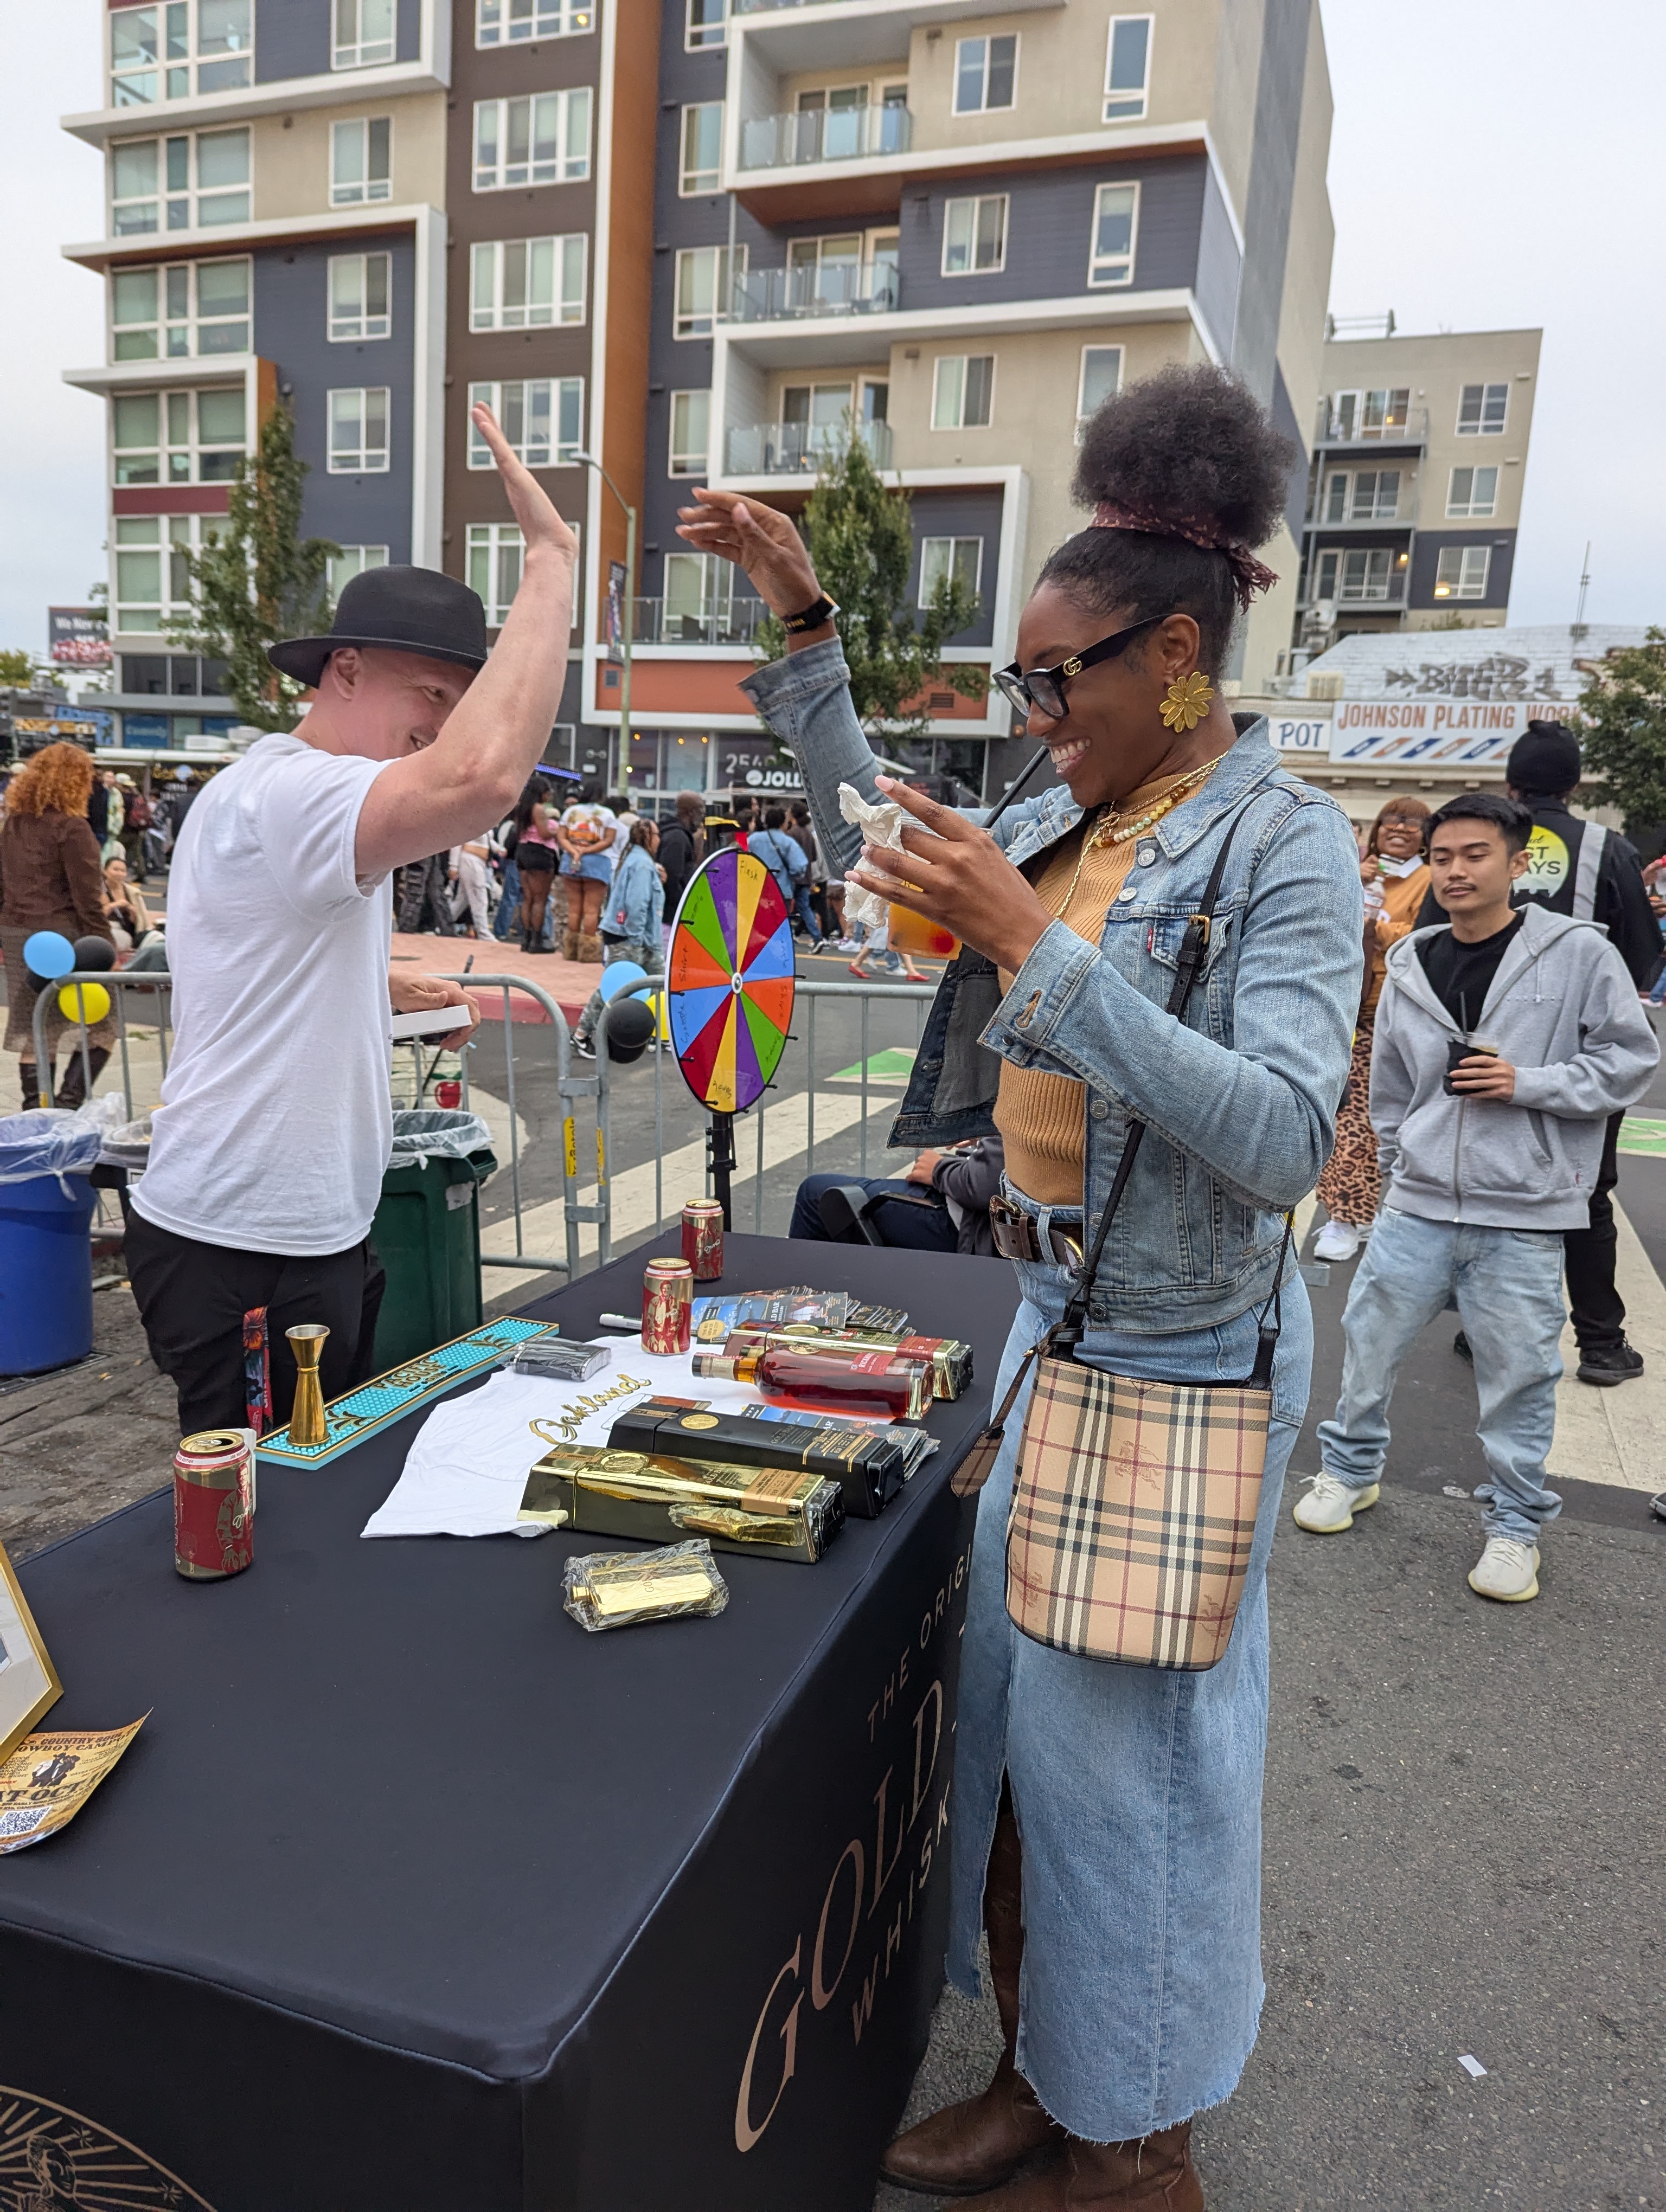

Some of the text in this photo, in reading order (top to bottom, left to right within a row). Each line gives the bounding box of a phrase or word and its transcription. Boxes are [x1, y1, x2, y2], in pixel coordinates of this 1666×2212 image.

[1338, 705, 1425, 730] JOHNSON
[1433, 705, 1515, 731] PLATING
[1279, 722, 1323, 748] POT
[740, 860, 758, 880] Flask
[772, 1302, 780, 1313] BAR
[372, 1358, 439, 1389] PACIFIC
[394, 1364, 447, 1388] HOUSE
[529, 1374, 652, 1445] Oakland
[868, 1645, 910, 1743] THE
[735, 1680, 943, 2153] GOLD
